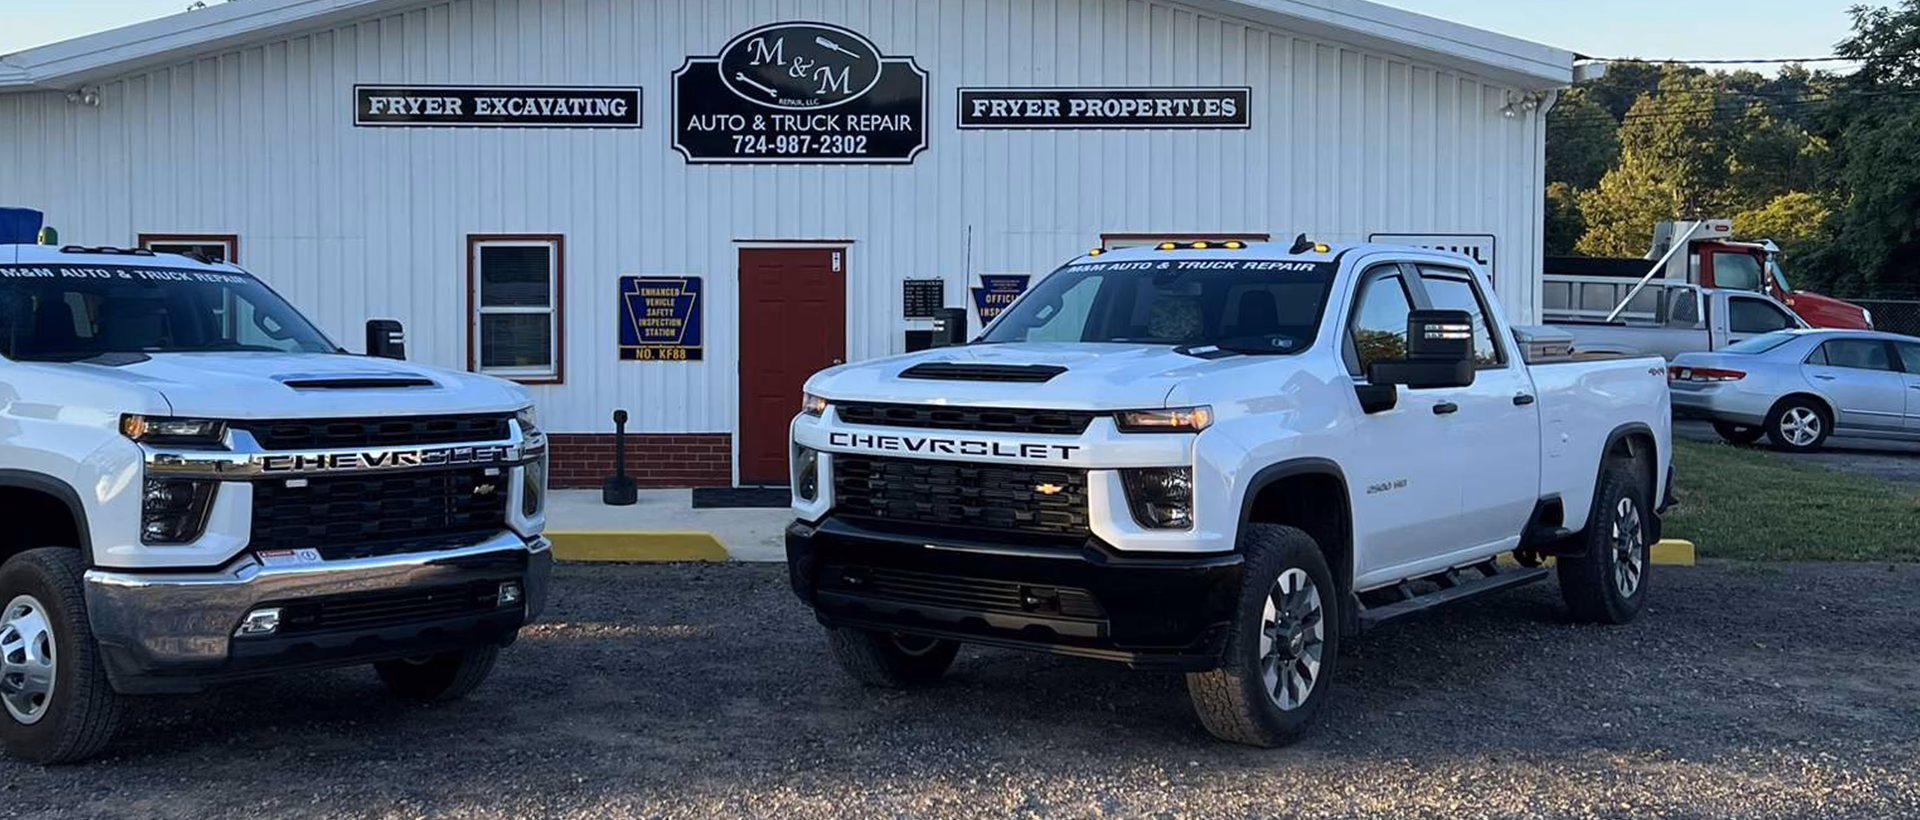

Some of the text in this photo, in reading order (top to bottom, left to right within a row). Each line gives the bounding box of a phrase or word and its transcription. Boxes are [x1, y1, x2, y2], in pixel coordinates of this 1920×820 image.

[747, 37, 852, 95] M & M
[368, 96, 628, 117] FRYER EXCAVATING
[971, 98, 1237, 118] FRYER PROPERTIES
[687, 114, 913, 132] AUTO & TRUCK REPAIR
[732, 135, 868, 154] 724-987-2302
[1107, 261, 1153, 271] AUTO
[1156, 261, 1170, 270] &
[1177, 261, 1239, 270] TRUCK
[1242, 261, 1316, 272] REPAIR
[0, 267, 247, 285] M&M AUTO & TRUCK REPAIR
[641, 288, 680, 297] ENHANCED
[985, 294, 1019, 304] OFFICI
[645, 298, 675, 307] VEHICLE
[646, 308, 674, 317] SAFETY
[638, 318, 682, 327] INSPECTION
[645, 328, 676, 337] STATION
[636, 348, 686, 360] NO. KF88
[829, 432, 1080, 460] CHEVROLET
[261, 444, 519, 472] CHEVROLET
